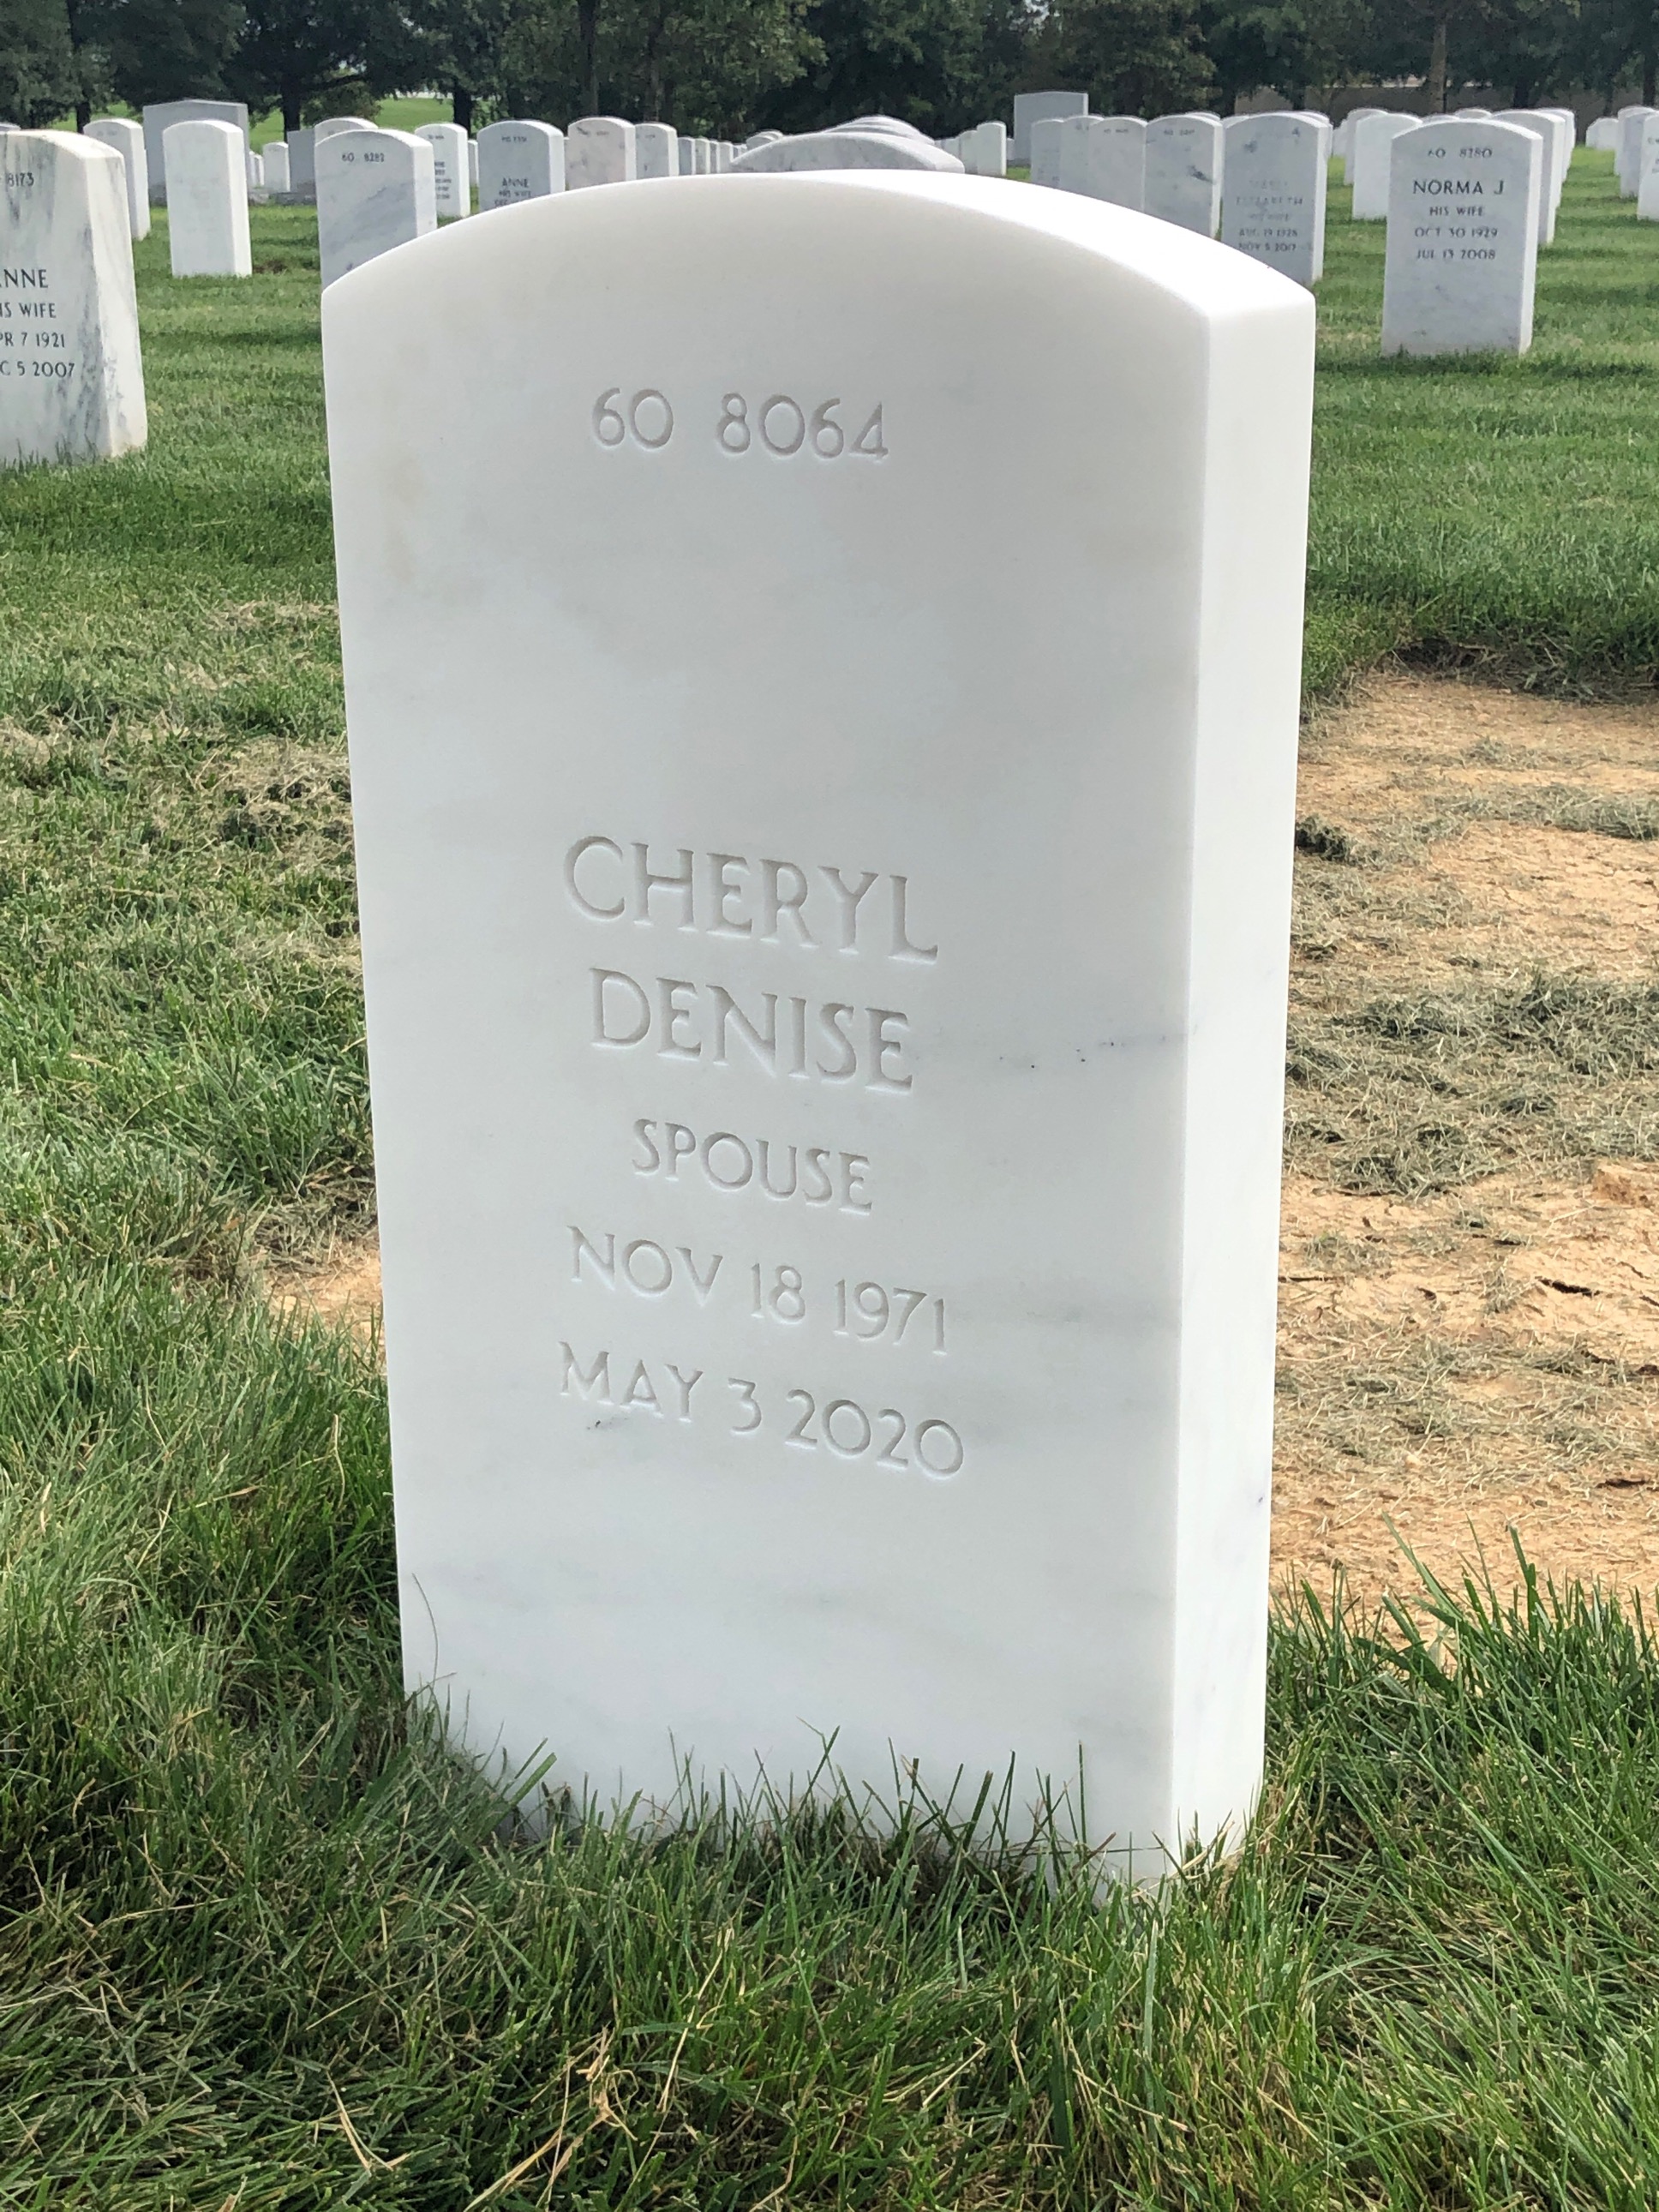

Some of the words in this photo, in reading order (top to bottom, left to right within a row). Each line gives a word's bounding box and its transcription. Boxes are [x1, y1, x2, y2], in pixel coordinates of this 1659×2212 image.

[7, 171, 34, 188] 8173
[1412, 179, 1483, 195] NORMA
[1494, 179, 1504, 195] J
[1429, 207, 1449, 216] HIS
[1456, 207, 1484, 216] WIFE
[1414, 226, 1441, 238] OCT
[1448, 226, 1466, 238] 30
[1471, 226, 1498, 238] 1929
[1416, 249, 1435, 260] JUL
[1442, 249, 1454, 260] 13
[1460, 249, 1496, 261] 2008
[0, 268, 49, 289] NNE
[18, 302, 57, 319] WIFE
[21, 331, 28, 347] 7
[36, 332, 66, 349] 1921
[16, 360, 26, 376] 5
[32, 361, 75, 379] 2007
[592, 387, 674, 449] 60
[716, 393, 889, 460] 8064
[563, 835, 939, 965] CHERYL
[589, 967, 913, 1094] DENISE
[632, 1118, 873, 1216] SPOUSE
[566, 1225, 724, 1308] NOV
[750, 1262, 807, 1324] 18
[833, 1278, 948, 1357] 1971
[558, 1340, 704, 1423] MAY
[727, 1377, 763, 1436] 3
[784, 1388, 965, 1480] 2020
